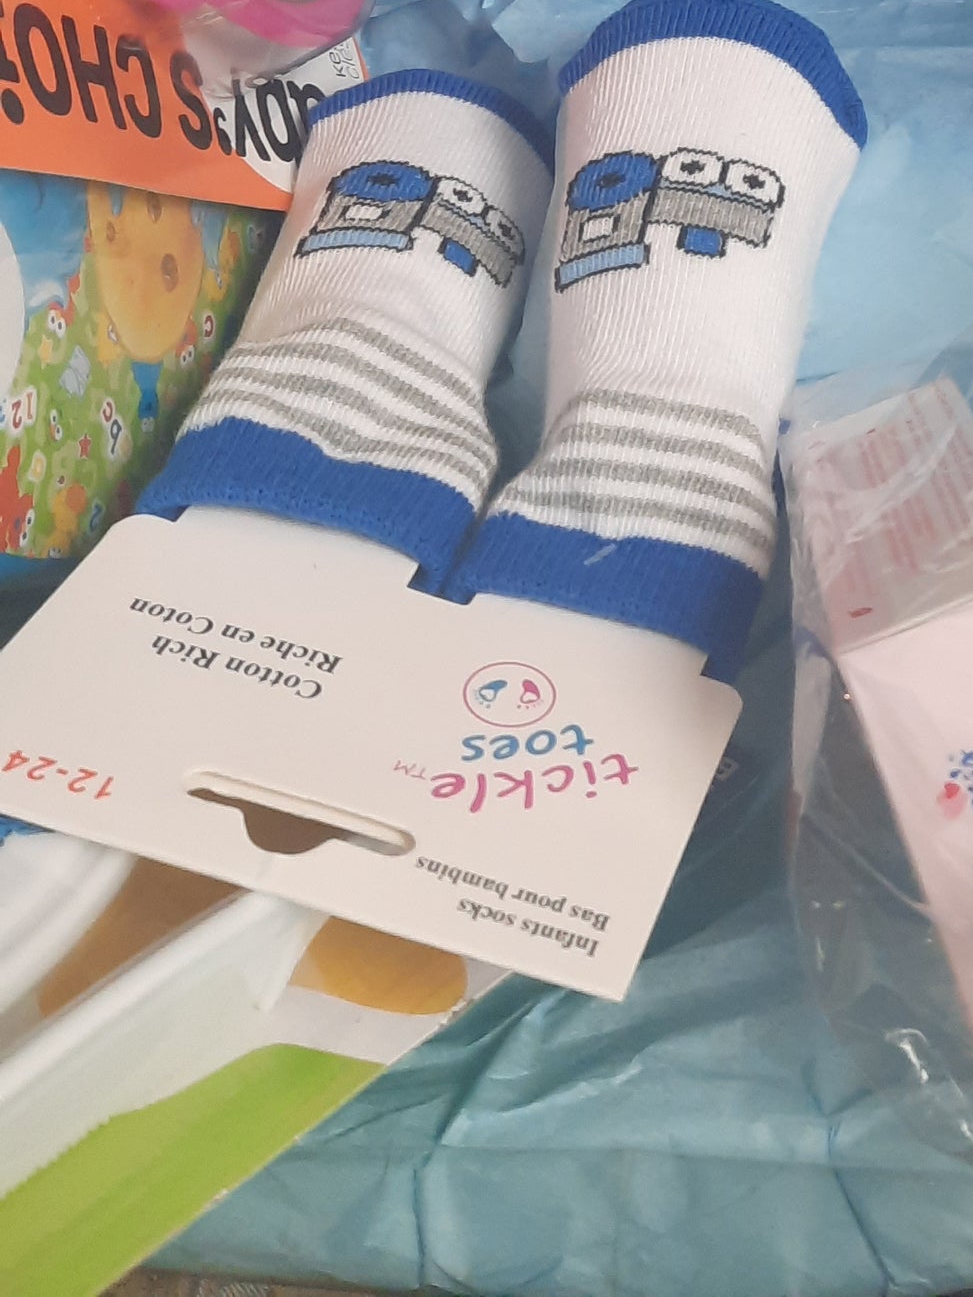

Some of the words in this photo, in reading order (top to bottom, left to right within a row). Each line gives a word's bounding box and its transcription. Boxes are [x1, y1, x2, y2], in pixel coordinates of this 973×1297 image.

[129, 597, 215, 638] Coton
[221, 624, 257, 646] en
[151, 633, 221, 669] Rich
[260, 636, 343, 676] Riche
[226, 655, 323, 700] Cotton
[462, 722, 594, 762] toes
[1, 749, 113, 800] 12-24
[430, 752, 640, 813] tickle
[415, 855, 510, 899] bambins
[457, 898, 515, 930] socks
[512, 888, 568, 920] pour
[571, 907, 611, 931] Bas
[536, 920, 600, 957] Infants
